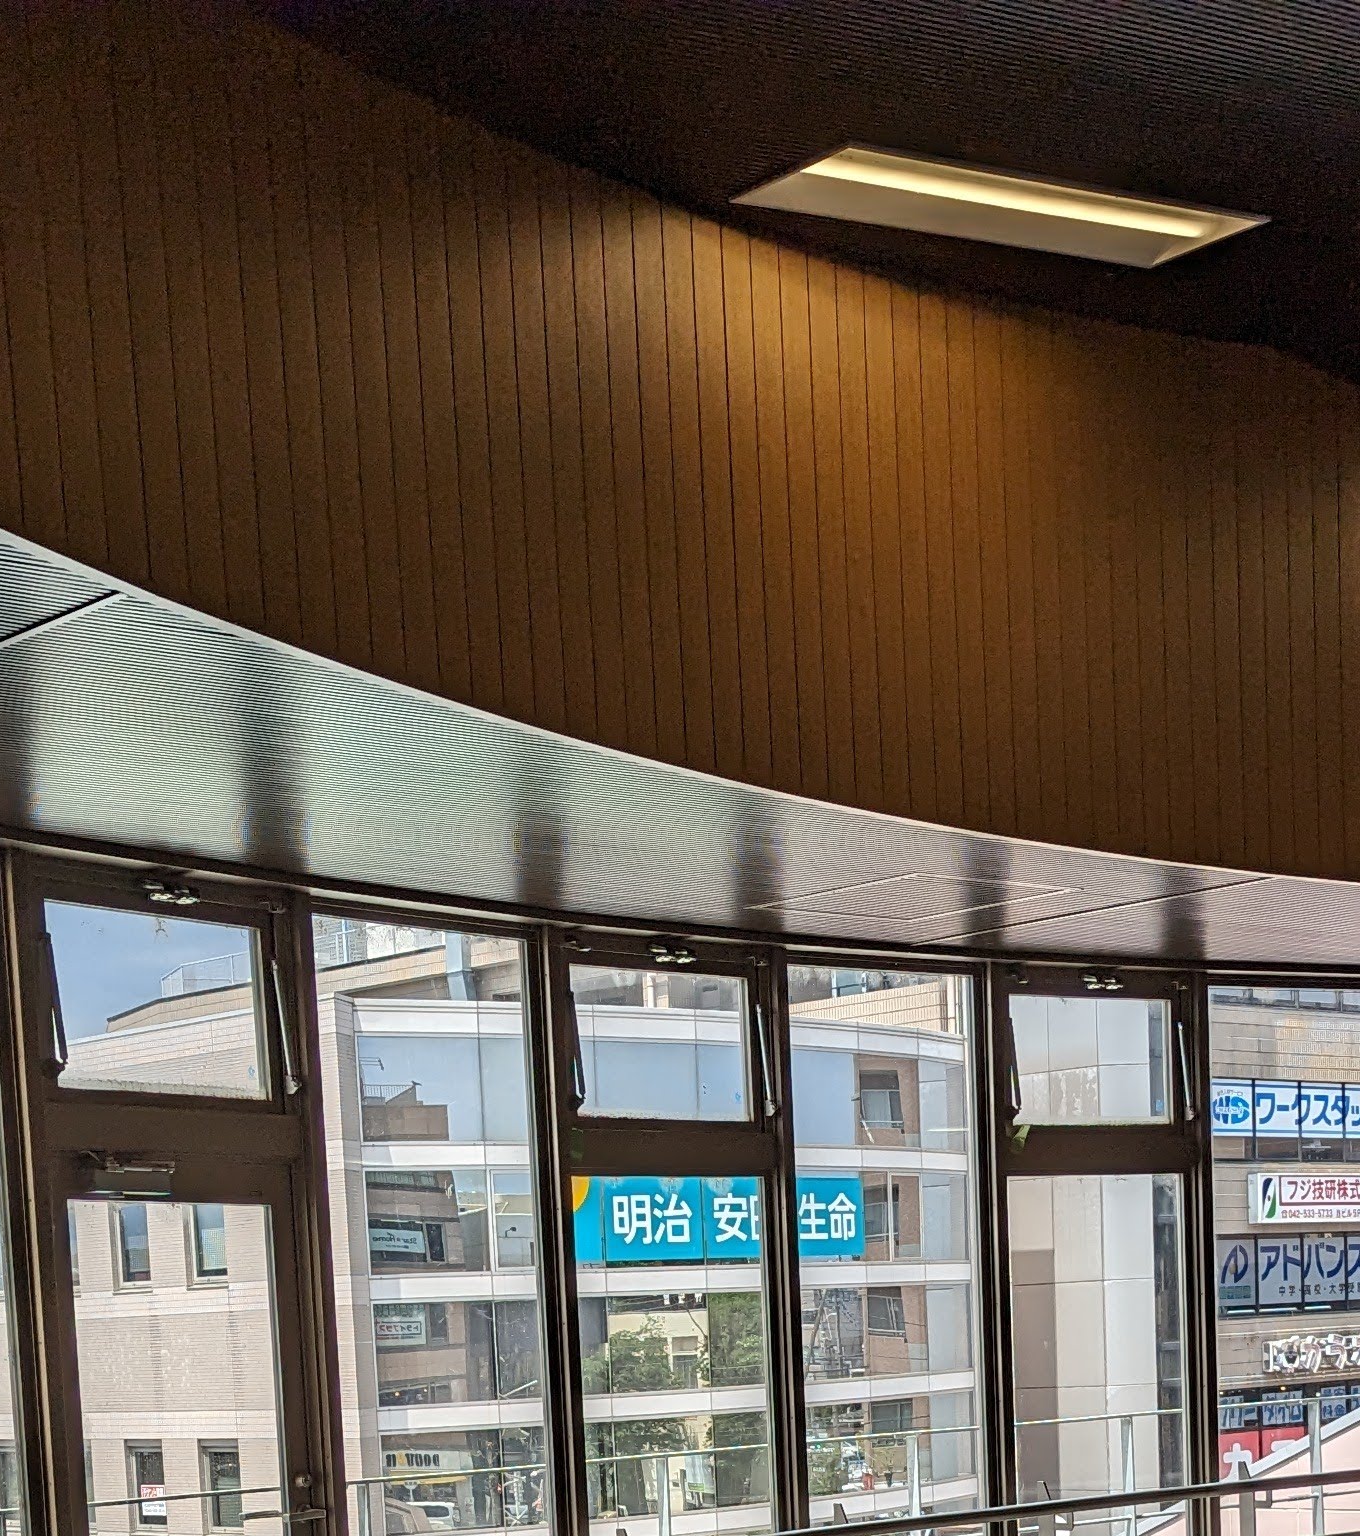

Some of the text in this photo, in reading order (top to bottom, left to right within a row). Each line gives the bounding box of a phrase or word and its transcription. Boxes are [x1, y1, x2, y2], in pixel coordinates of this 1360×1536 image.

[612, 1191, 857, 1244] 明治安生命
